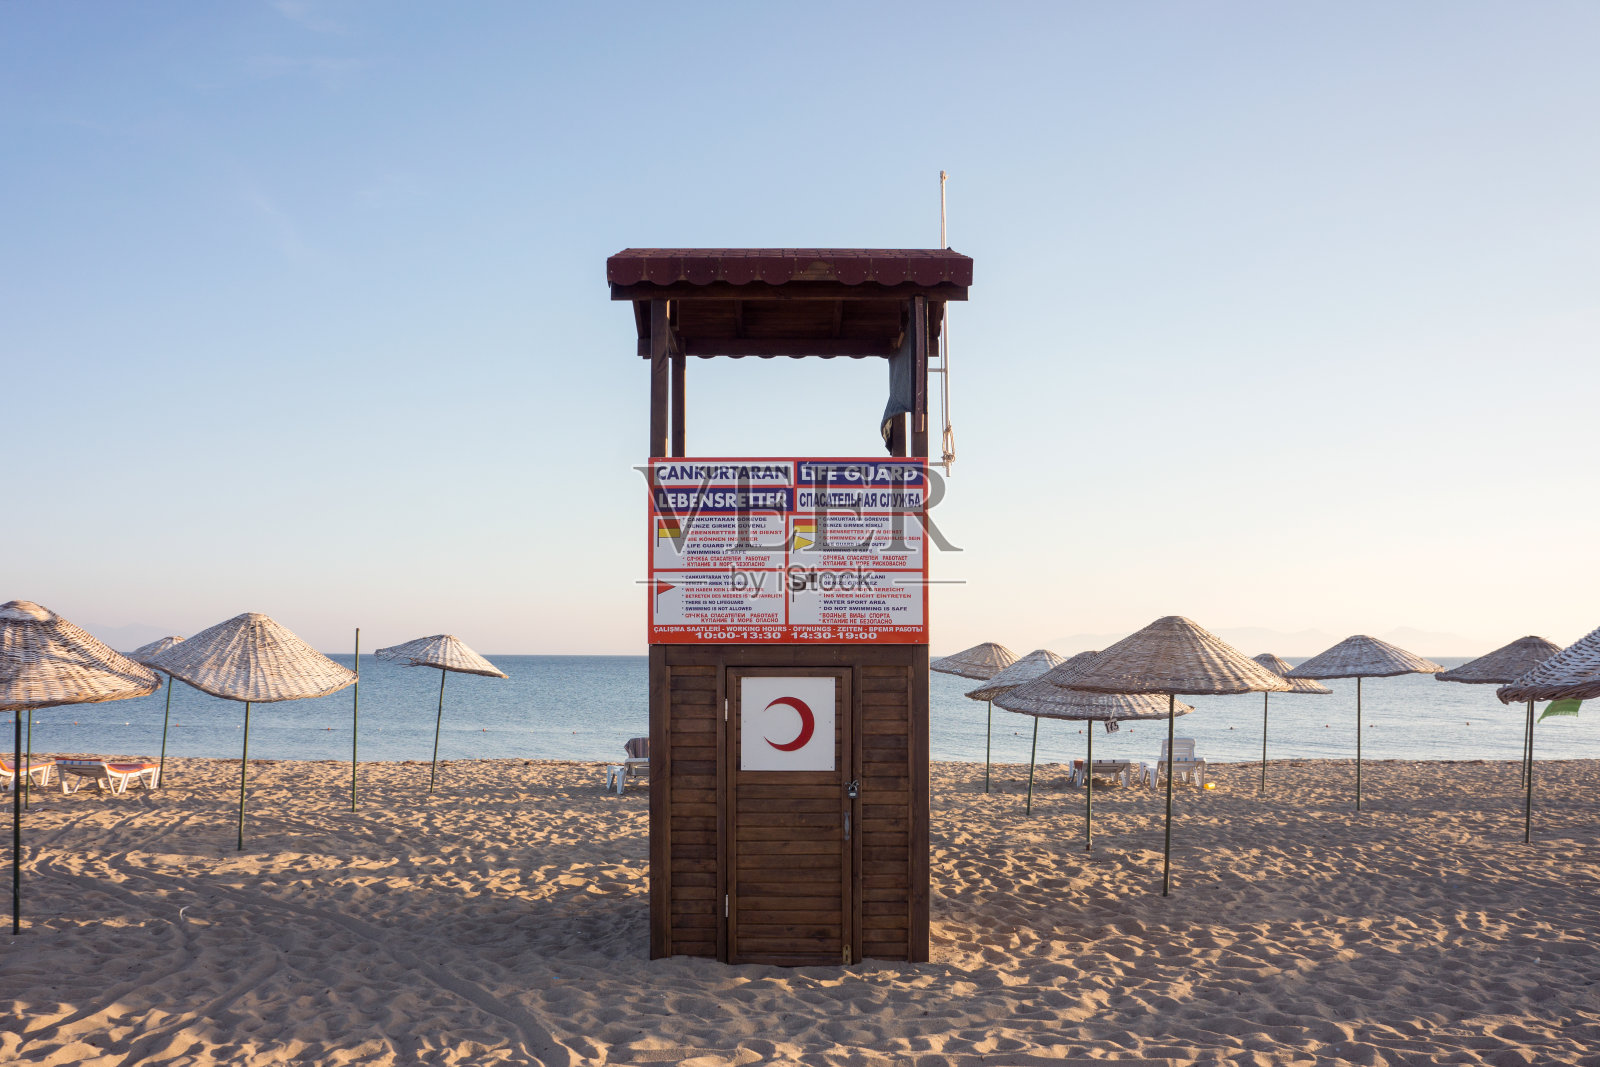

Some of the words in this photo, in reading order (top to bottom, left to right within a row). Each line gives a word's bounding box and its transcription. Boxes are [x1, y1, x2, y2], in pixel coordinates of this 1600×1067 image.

[657, 466, 788, 480] CANKURTARAN
[802, 466, 837, 480] LIFE
[845, 466, 918, 480] GUARD
[659, 493, 787, 507] LEBENSRETTER
[800, 493, 877, 507] СПАСАТЕЛЬНАЯ
[880, 493, 920, 507] СЛУЖБА
